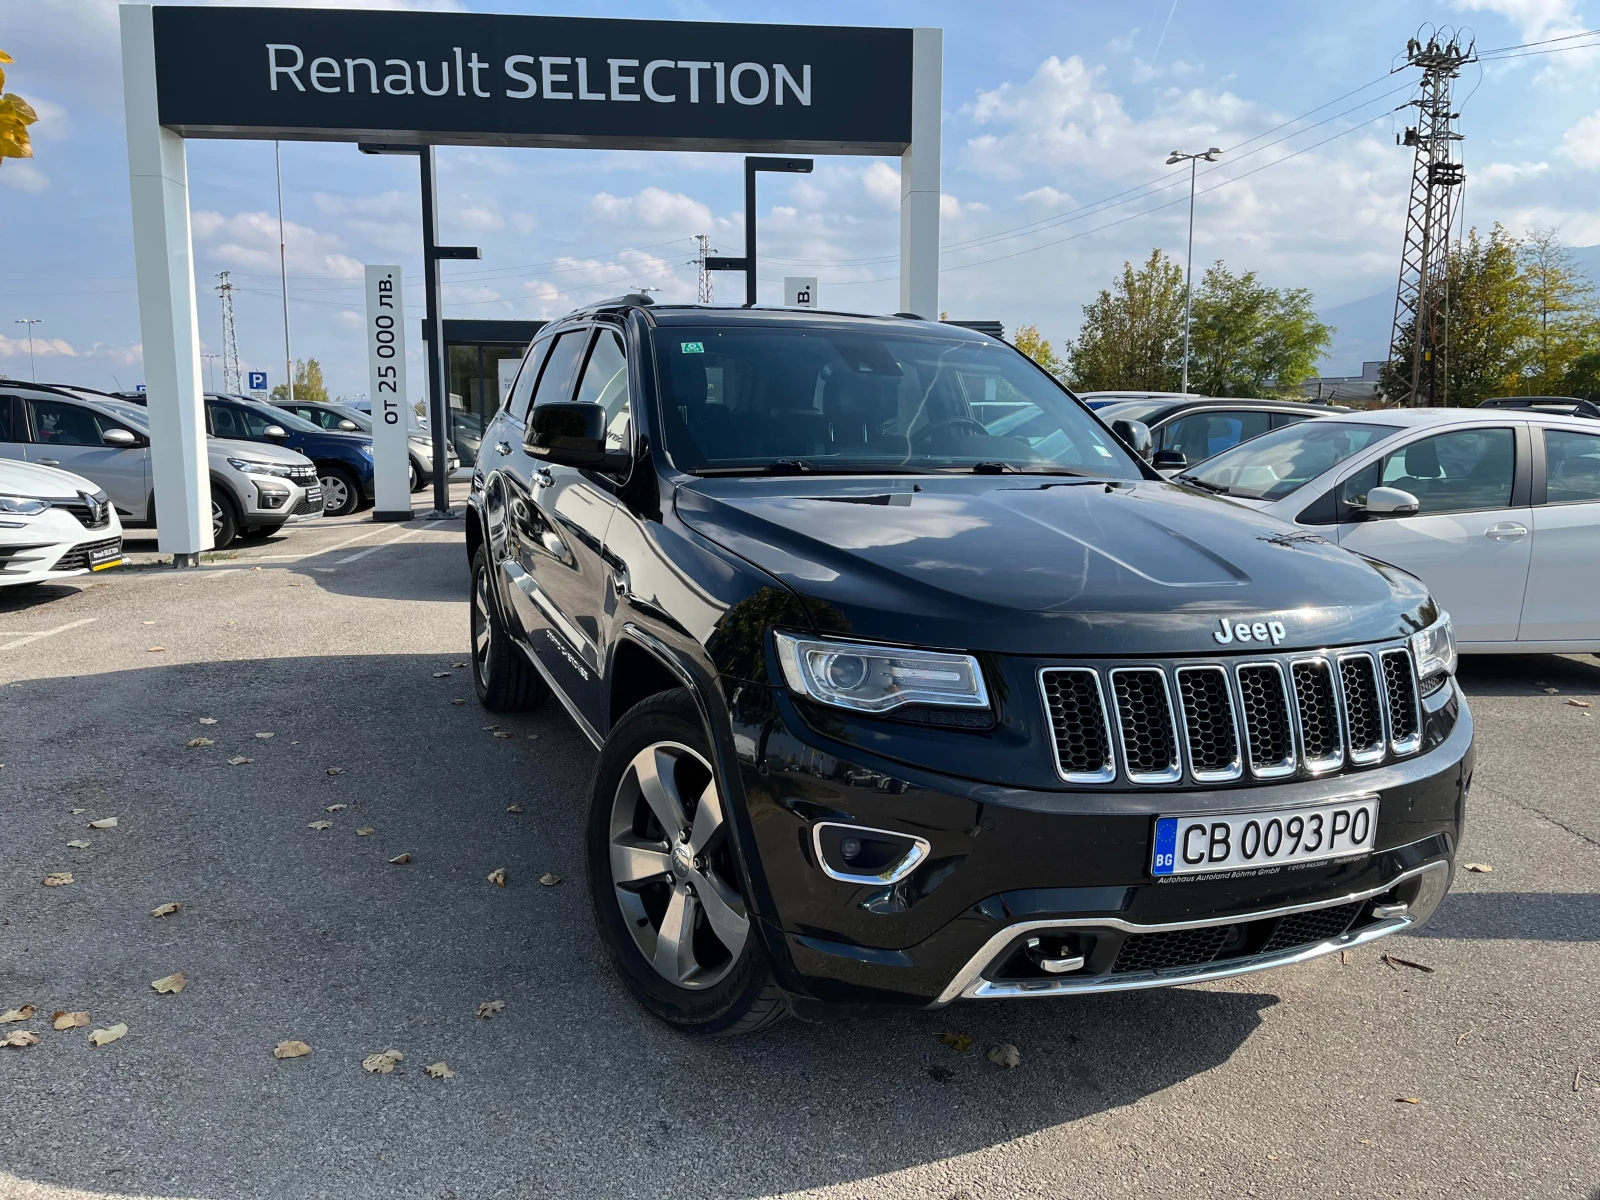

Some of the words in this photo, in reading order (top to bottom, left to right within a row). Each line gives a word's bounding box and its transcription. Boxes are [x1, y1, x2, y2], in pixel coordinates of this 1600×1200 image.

[265, 43, 491, 99] Renault
[503, 54, 813, 107] SELECTION
[379, 273, 394, 309] лв.
[375, 315, 396, 358] 000
[252, 373, 263, 388] P
[378, 365, 397, 393] 25
[384, 400, 398, 425] от
[1212, 618, 1286, 646] Jeep
[1182, 821, 1231, 865] CB
[1241, 812, 1324, 860] 0093
[1329, 806, 1370, 850] PO
[1155, 853, 1173, 867] BG
[1157, 875, 1195, 884] Autohaus
[1195, 872, 1230, 882] Autoland
[1231, 869, 1257, 879] Böhme
[1257, 866, 1281, 876] GmbH
